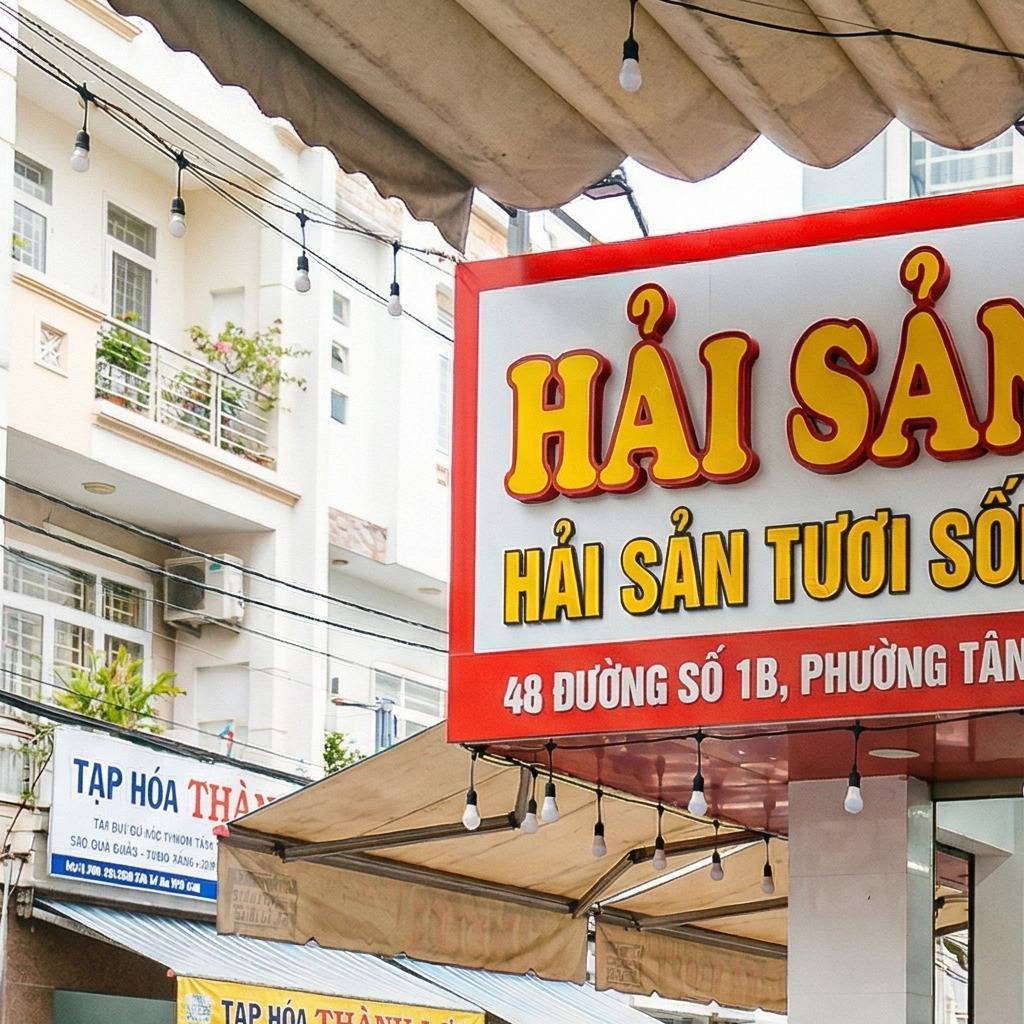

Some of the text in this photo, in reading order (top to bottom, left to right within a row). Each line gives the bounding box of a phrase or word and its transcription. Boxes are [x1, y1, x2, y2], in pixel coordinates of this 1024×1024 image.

[504, 283, 760, 502] HẢI
[503, 517, 602, 625] HẢI
[620, 505, 748, 616] SẢN
[765, 507, 910, 604] TƯƠI
[504, 672, 543, 715] 48
[553, 658, 668, 711] ĐƯỜNG
[679, 643, 726, 703] SỐ
[736, 657, 789, 703] 1B,
[801, 636, 948, 696] PHƯỜNG
[74, 758, 123, 805] TẠP
[131, 766, 179, 814] HÓA
